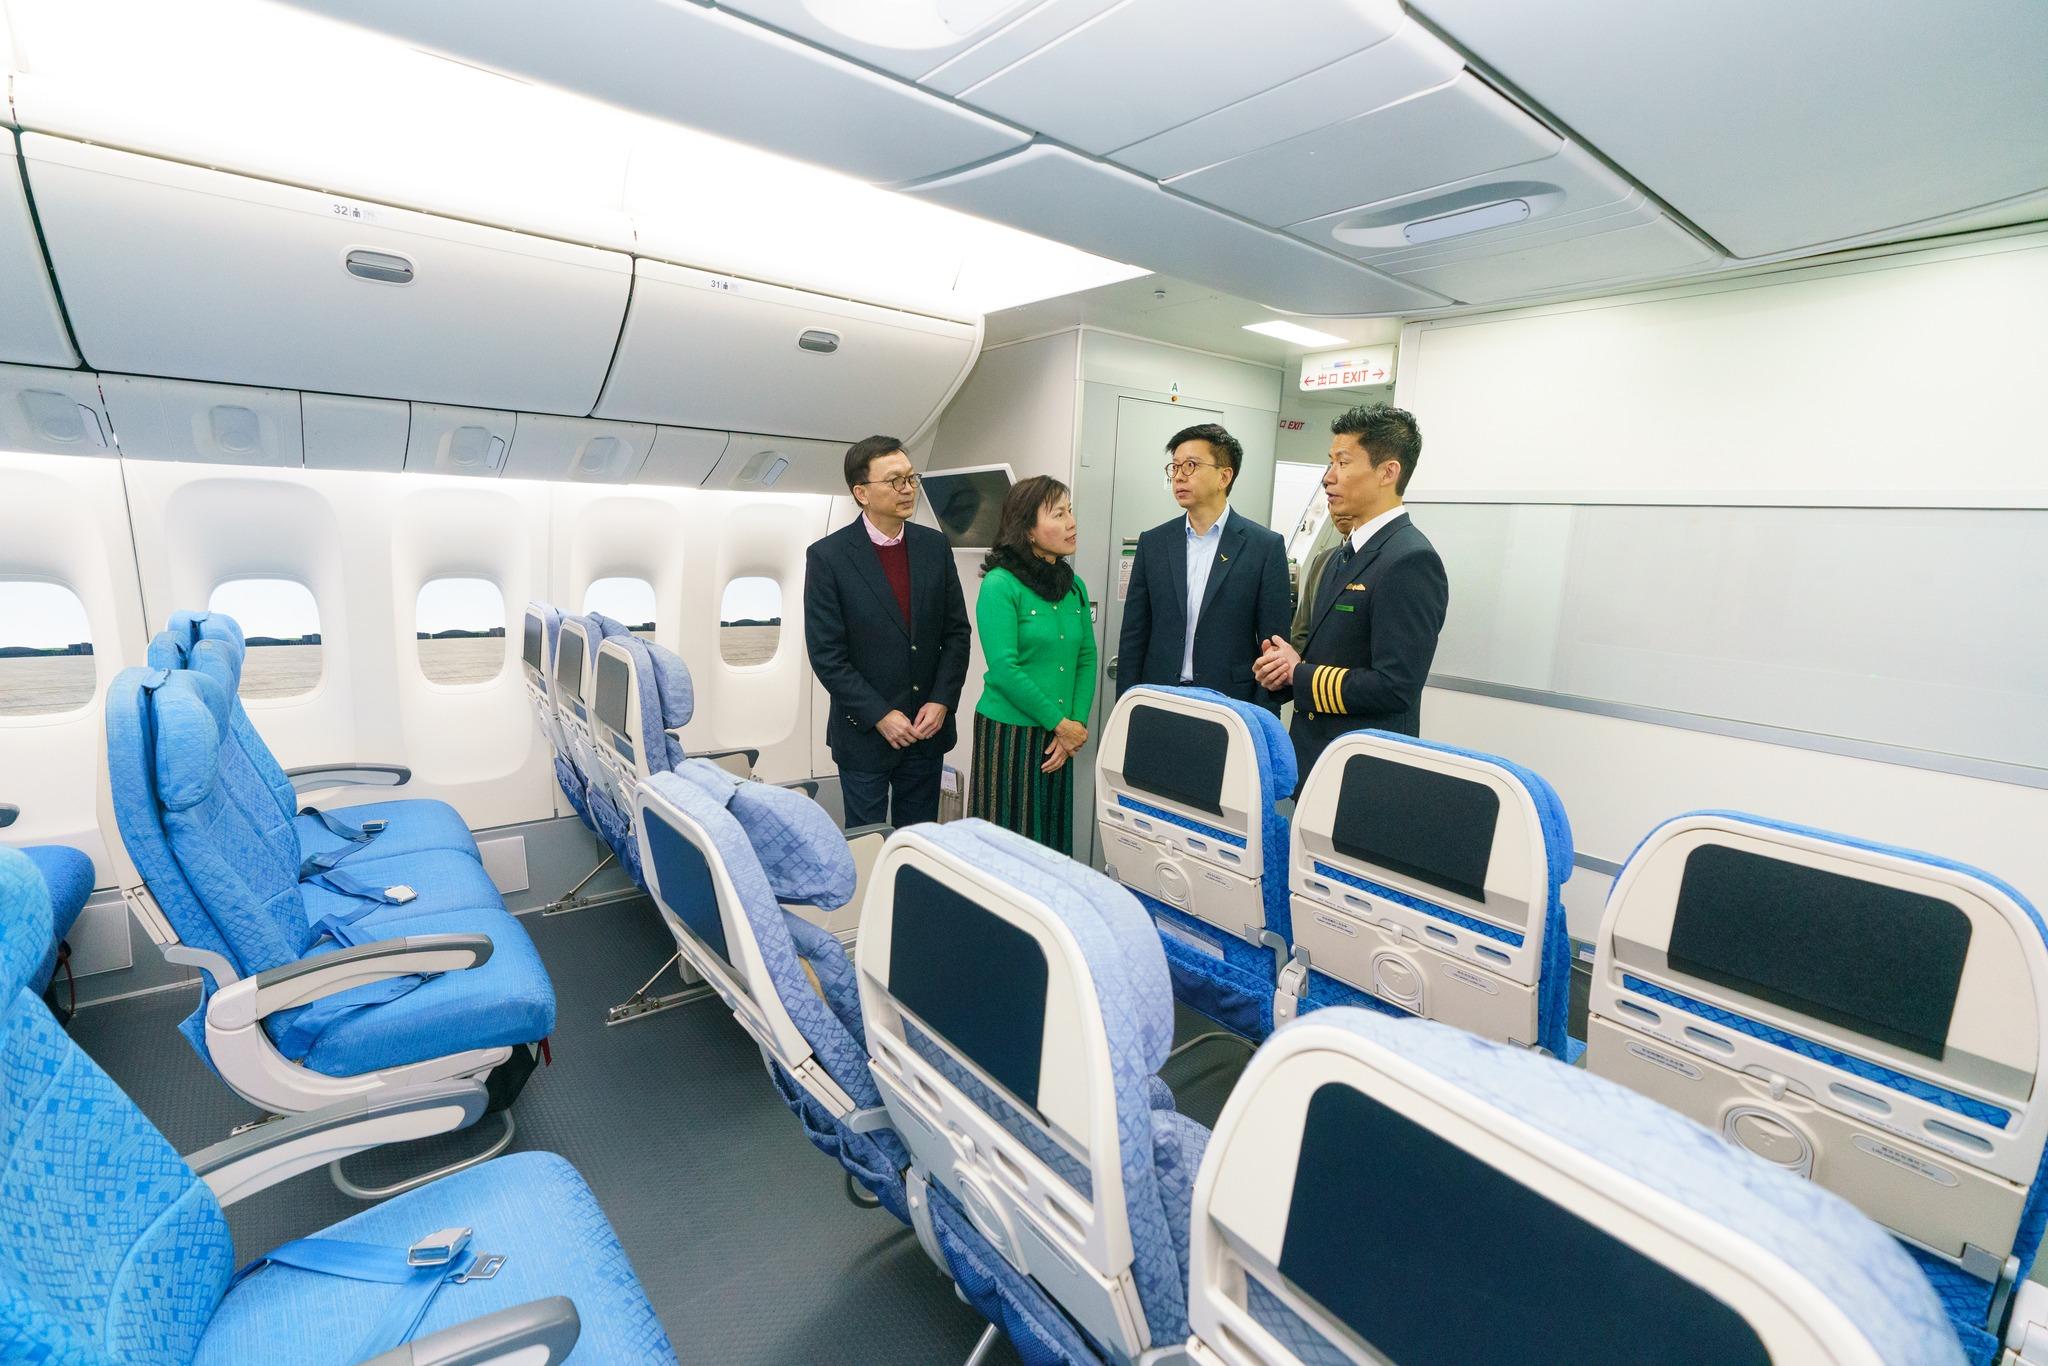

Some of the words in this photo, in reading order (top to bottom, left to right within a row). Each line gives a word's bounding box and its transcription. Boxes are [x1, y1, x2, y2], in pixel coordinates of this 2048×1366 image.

[333, 204, 348, 216] 32
[711, 279, 720, 289] 31
[1317, 373, 1338, 386] 出口
[1342, 370, 1368, 384] EXIT
[1171, 382, 1178, 392] A
[1280, 420, 1287, 428] 口
[1288, 421, 1305, 430] EXIT
